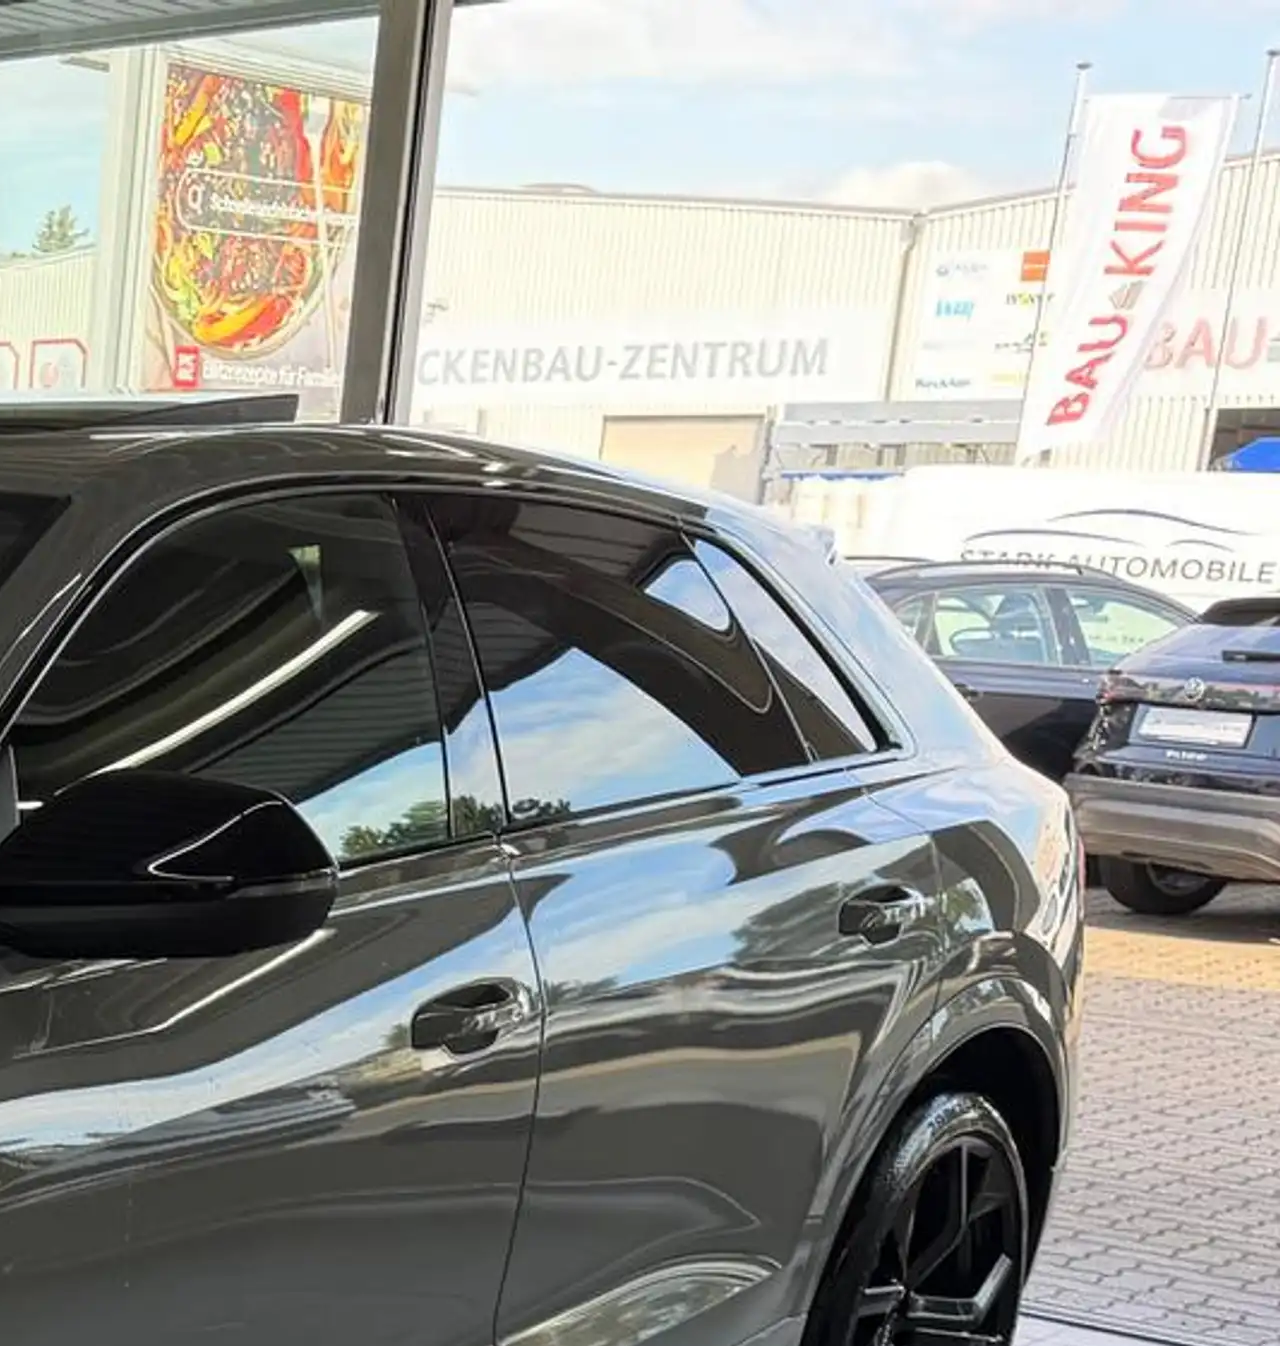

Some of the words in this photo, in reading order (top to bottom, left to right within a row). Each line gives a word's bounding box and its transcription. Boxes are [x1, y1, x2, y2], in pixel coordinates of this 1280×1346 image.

[1046, 313, 1130, 425] BAU
[1103, 125, 1188, 277] KING
[417, 337, 830, 386] CKENBAU-ZENTRUM
[1143, 316, 1268, 370] BAU
